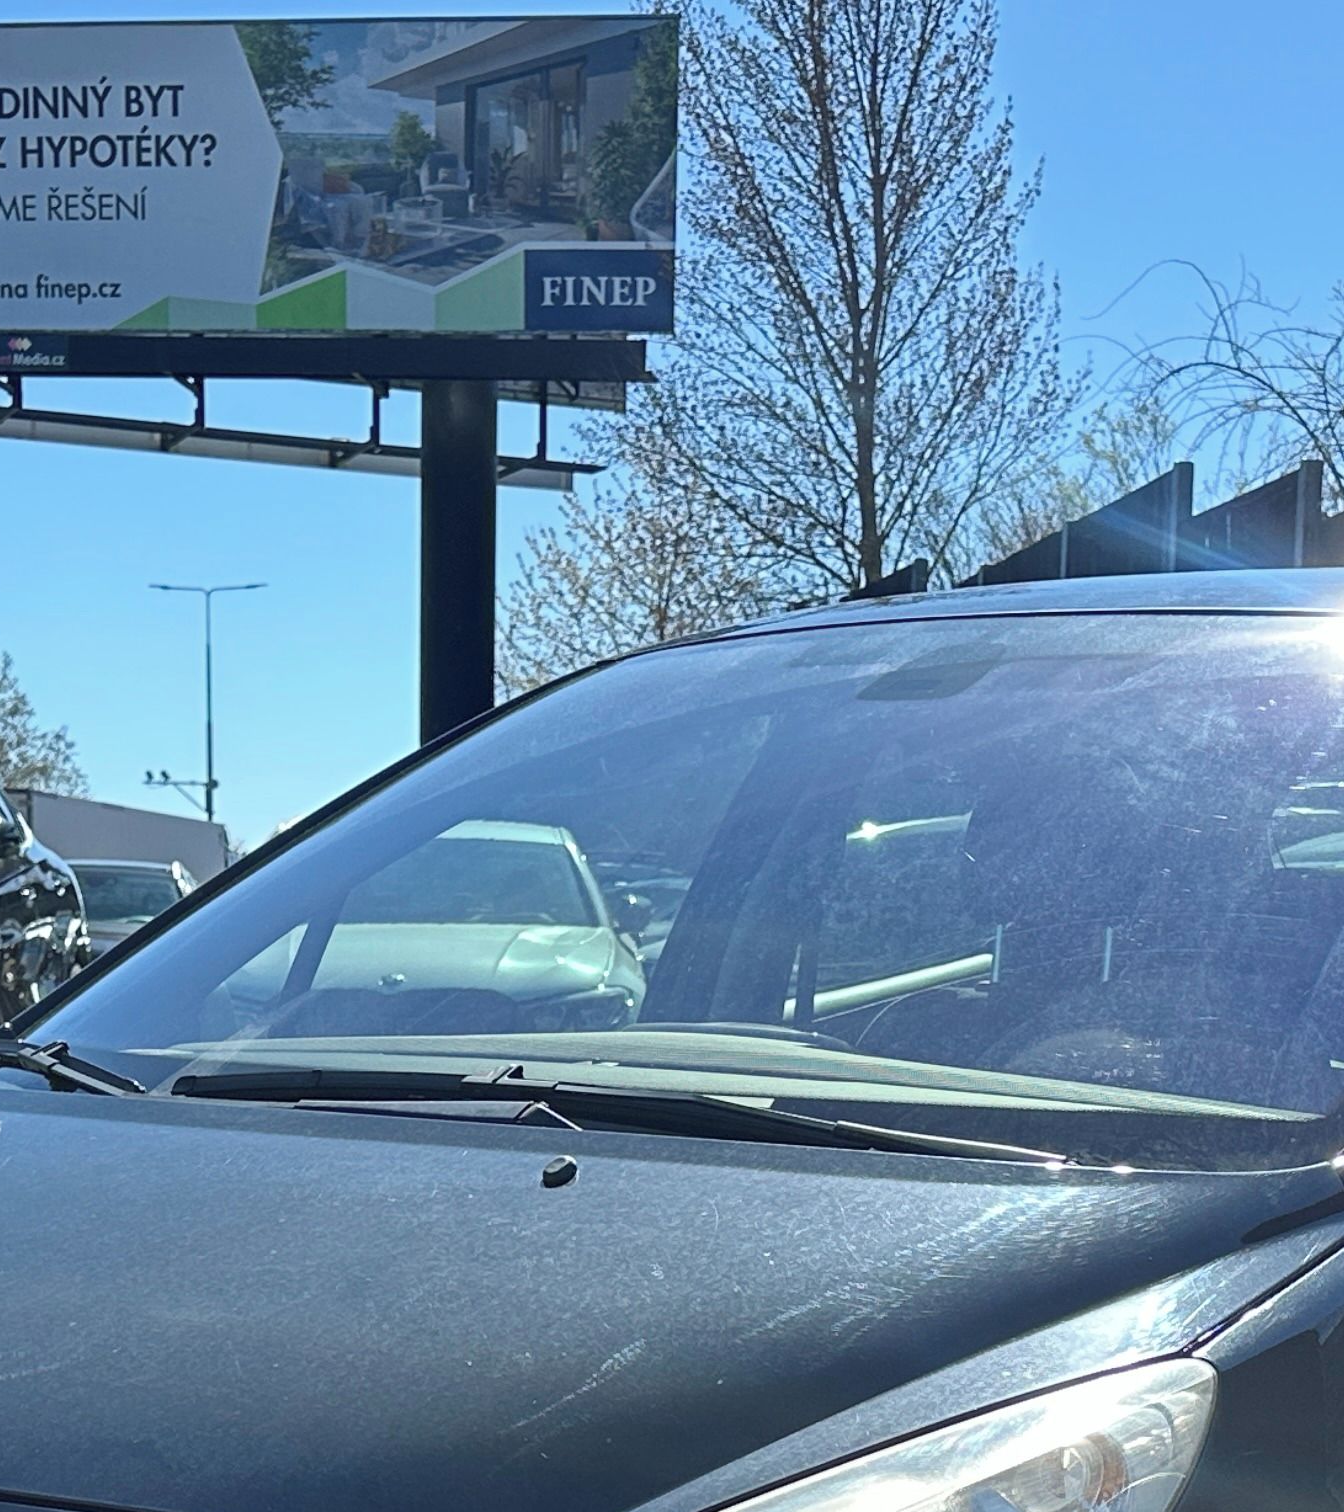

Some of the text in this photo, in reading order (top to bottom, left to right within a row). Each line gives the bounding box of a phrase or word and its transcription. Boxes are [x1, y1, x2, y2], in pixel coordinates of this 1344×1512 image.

[124, 84, 184, 118] BYT
[19, 125, 217, 169] HYPOTÉKY?
[46, 186, 148, 222] ŘEŠENÍ
[0, 282, 29, 299] na
[35, 273, 122, 305] finep.cz
[540, 276, 657, 307] FINEP
